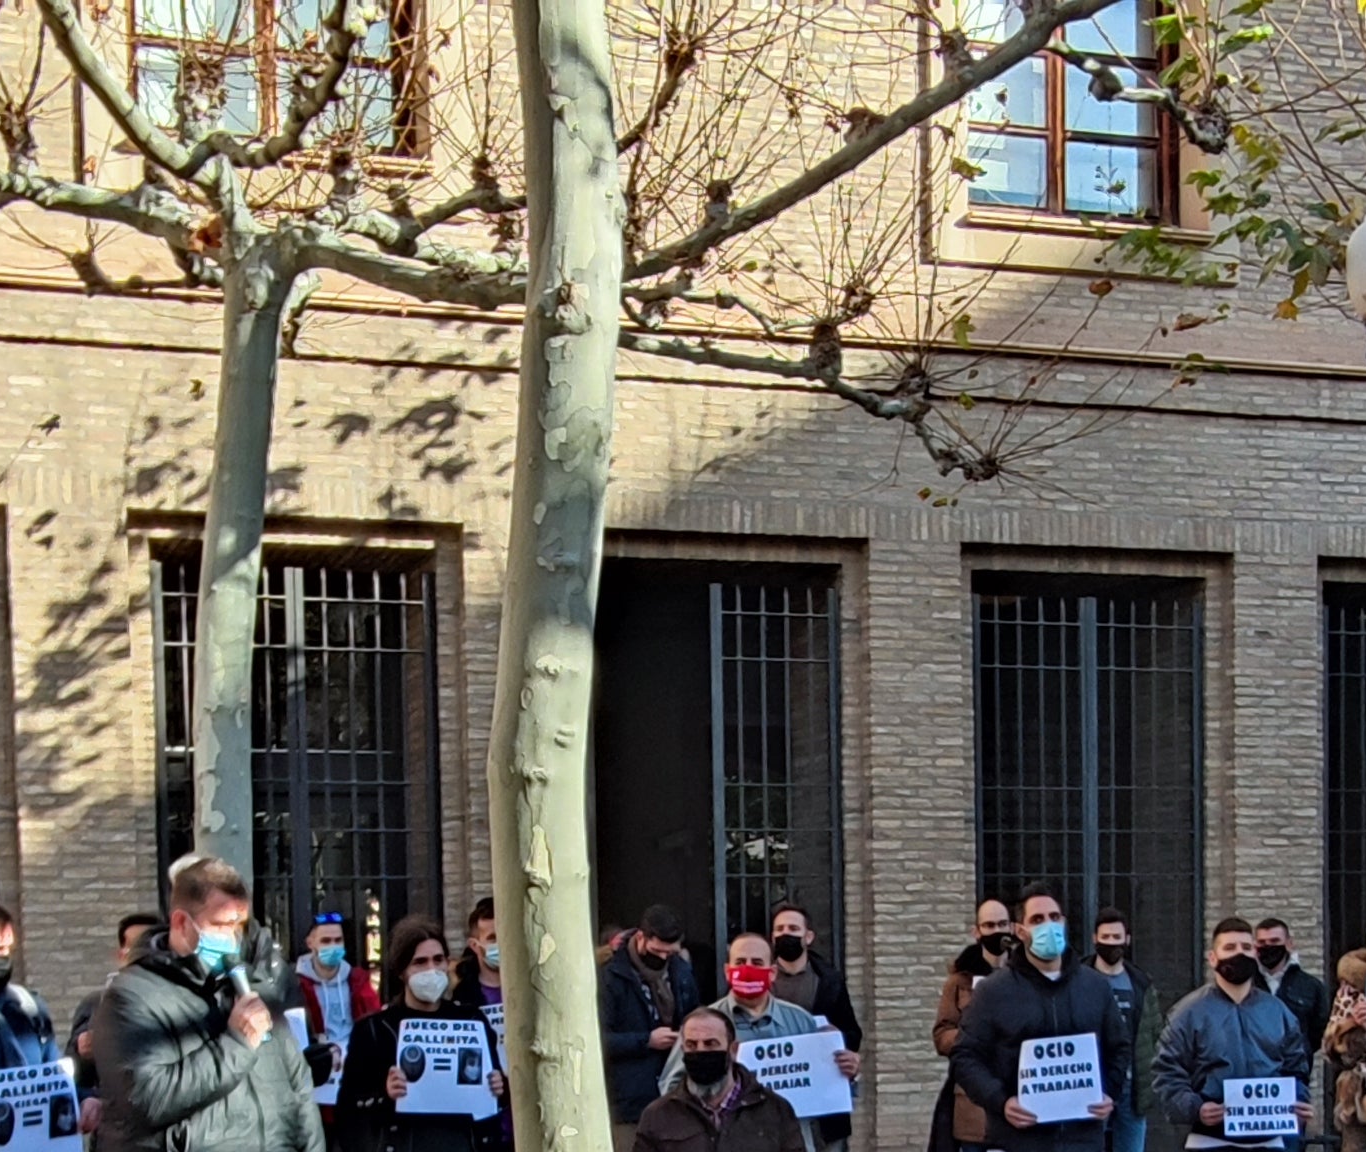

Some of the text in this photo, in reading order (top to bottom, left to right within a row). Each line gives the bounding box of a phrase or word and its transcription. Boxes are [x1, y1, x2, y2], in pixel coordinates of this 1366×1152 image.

[404, 1021, 478, 1032] JUEGO DEL
[403, 1034, 479, 1045] GALLINITA
[425, 1047, 457, 1055] CIEGA
[754, 1042, 794, 1061] OCIO
[1033, 1041, 1075, 1060] OCIO
[760, 1062, 810, 1077] DERECHO
[1020, 1062, 1092, 1079] SIN DERECHO
[1021, 1078, 1094, 1095] A TRABAJAR
[1243, 1083, 1280, 1099] OCIO
[15, 1097, 48, 1109] CIEGA
[1227, 1104, 1295, 1116] SIN DERECHO
[1228, 1119, 1295, 1131] A TRABAJAR
